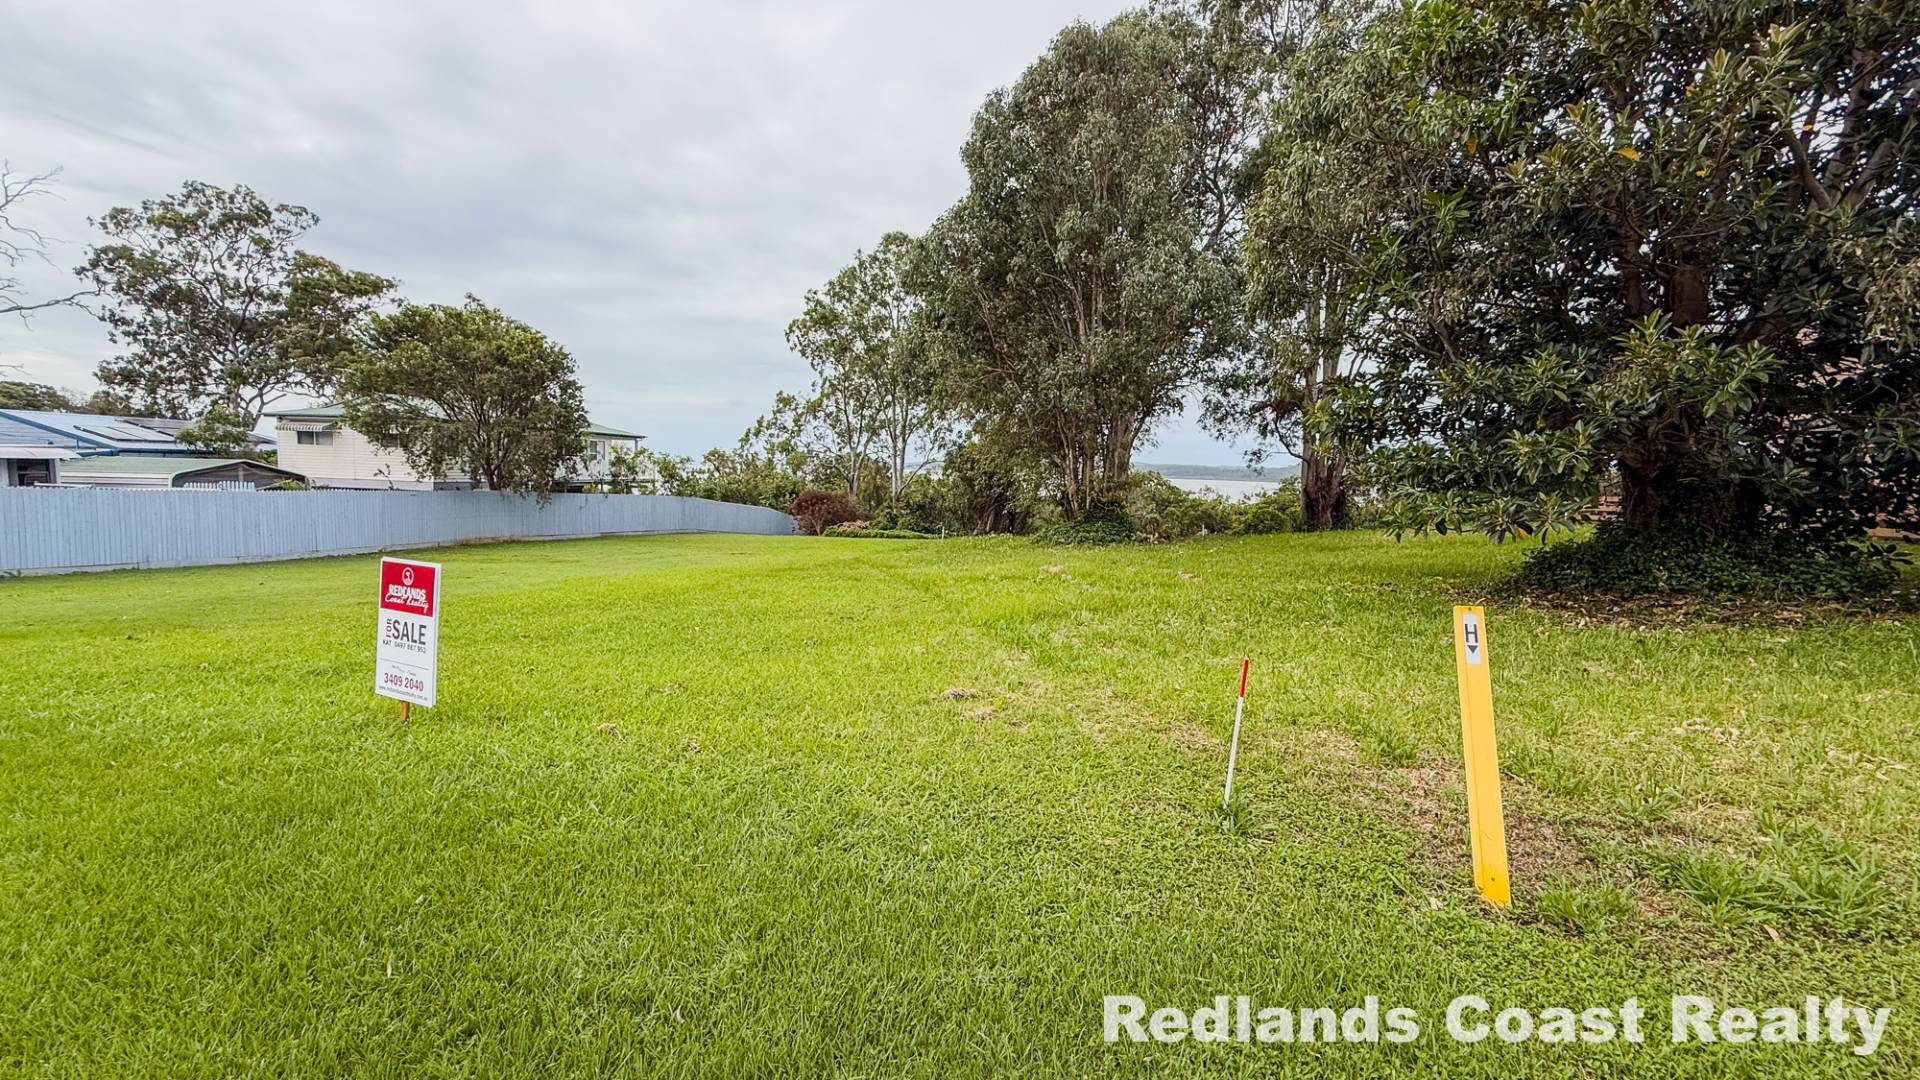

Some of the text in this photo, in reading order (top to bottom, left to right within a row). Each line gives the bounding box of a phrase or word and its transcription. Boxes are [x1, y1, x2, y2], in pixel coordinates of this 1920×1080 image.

[385, 593, 406, 605] Coast
[388, 584, 426, 601] REDLANDS
[385, 618, 393, 638] FOR
[392, 619, 427, 646] SALE
[1465, 623, 1478, 643] H
[384, 672, 424, 692] 3409 2040
